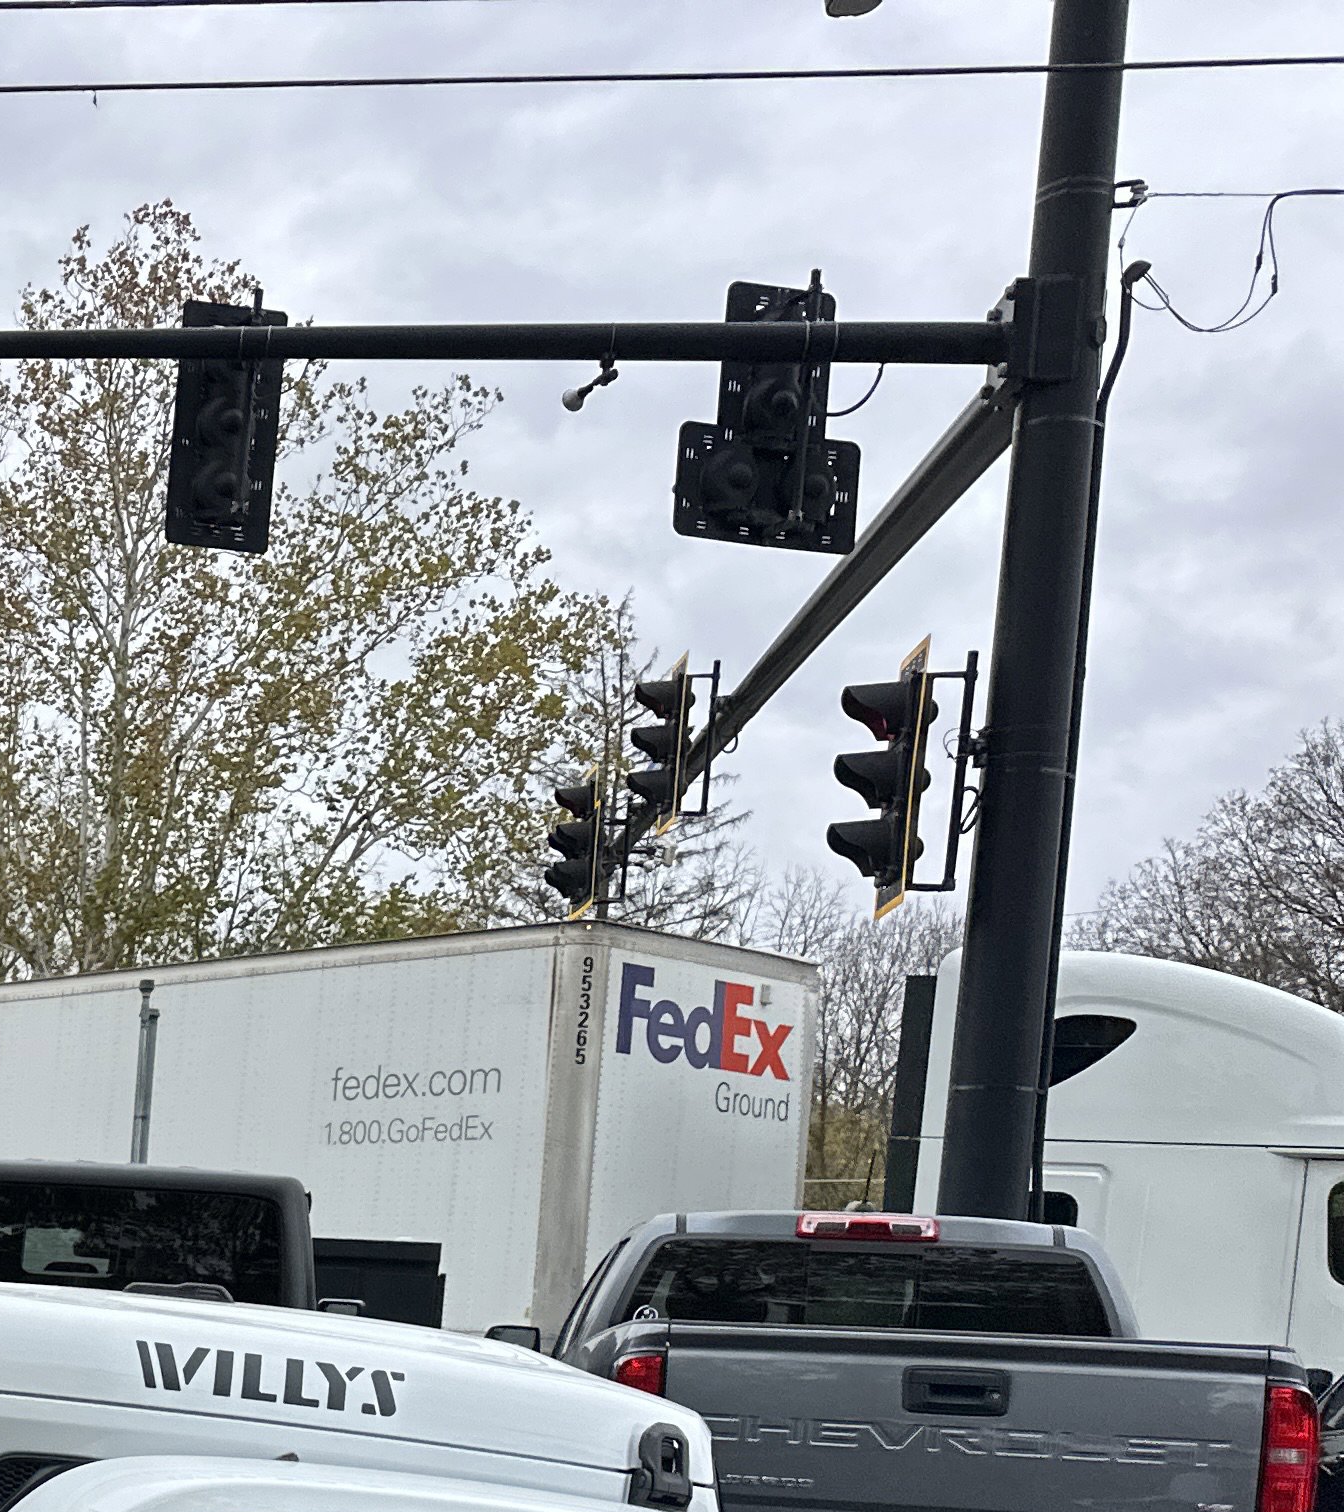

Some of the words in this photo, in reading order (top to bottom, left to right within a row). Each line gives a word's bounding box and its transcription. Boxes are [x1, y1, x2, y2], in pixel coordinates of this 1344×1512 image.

[575, 957, 594, 1064] 953265
[616, 962, 794, 1081] FedEx
[331, 1065, 502, 1101] fedex.com
[715, 1082, 790, 1121] Ground
[325, 1115, 494, 1145] 1.800.GoFedEx
[136, 1340, 406, 1417] WILLYS
